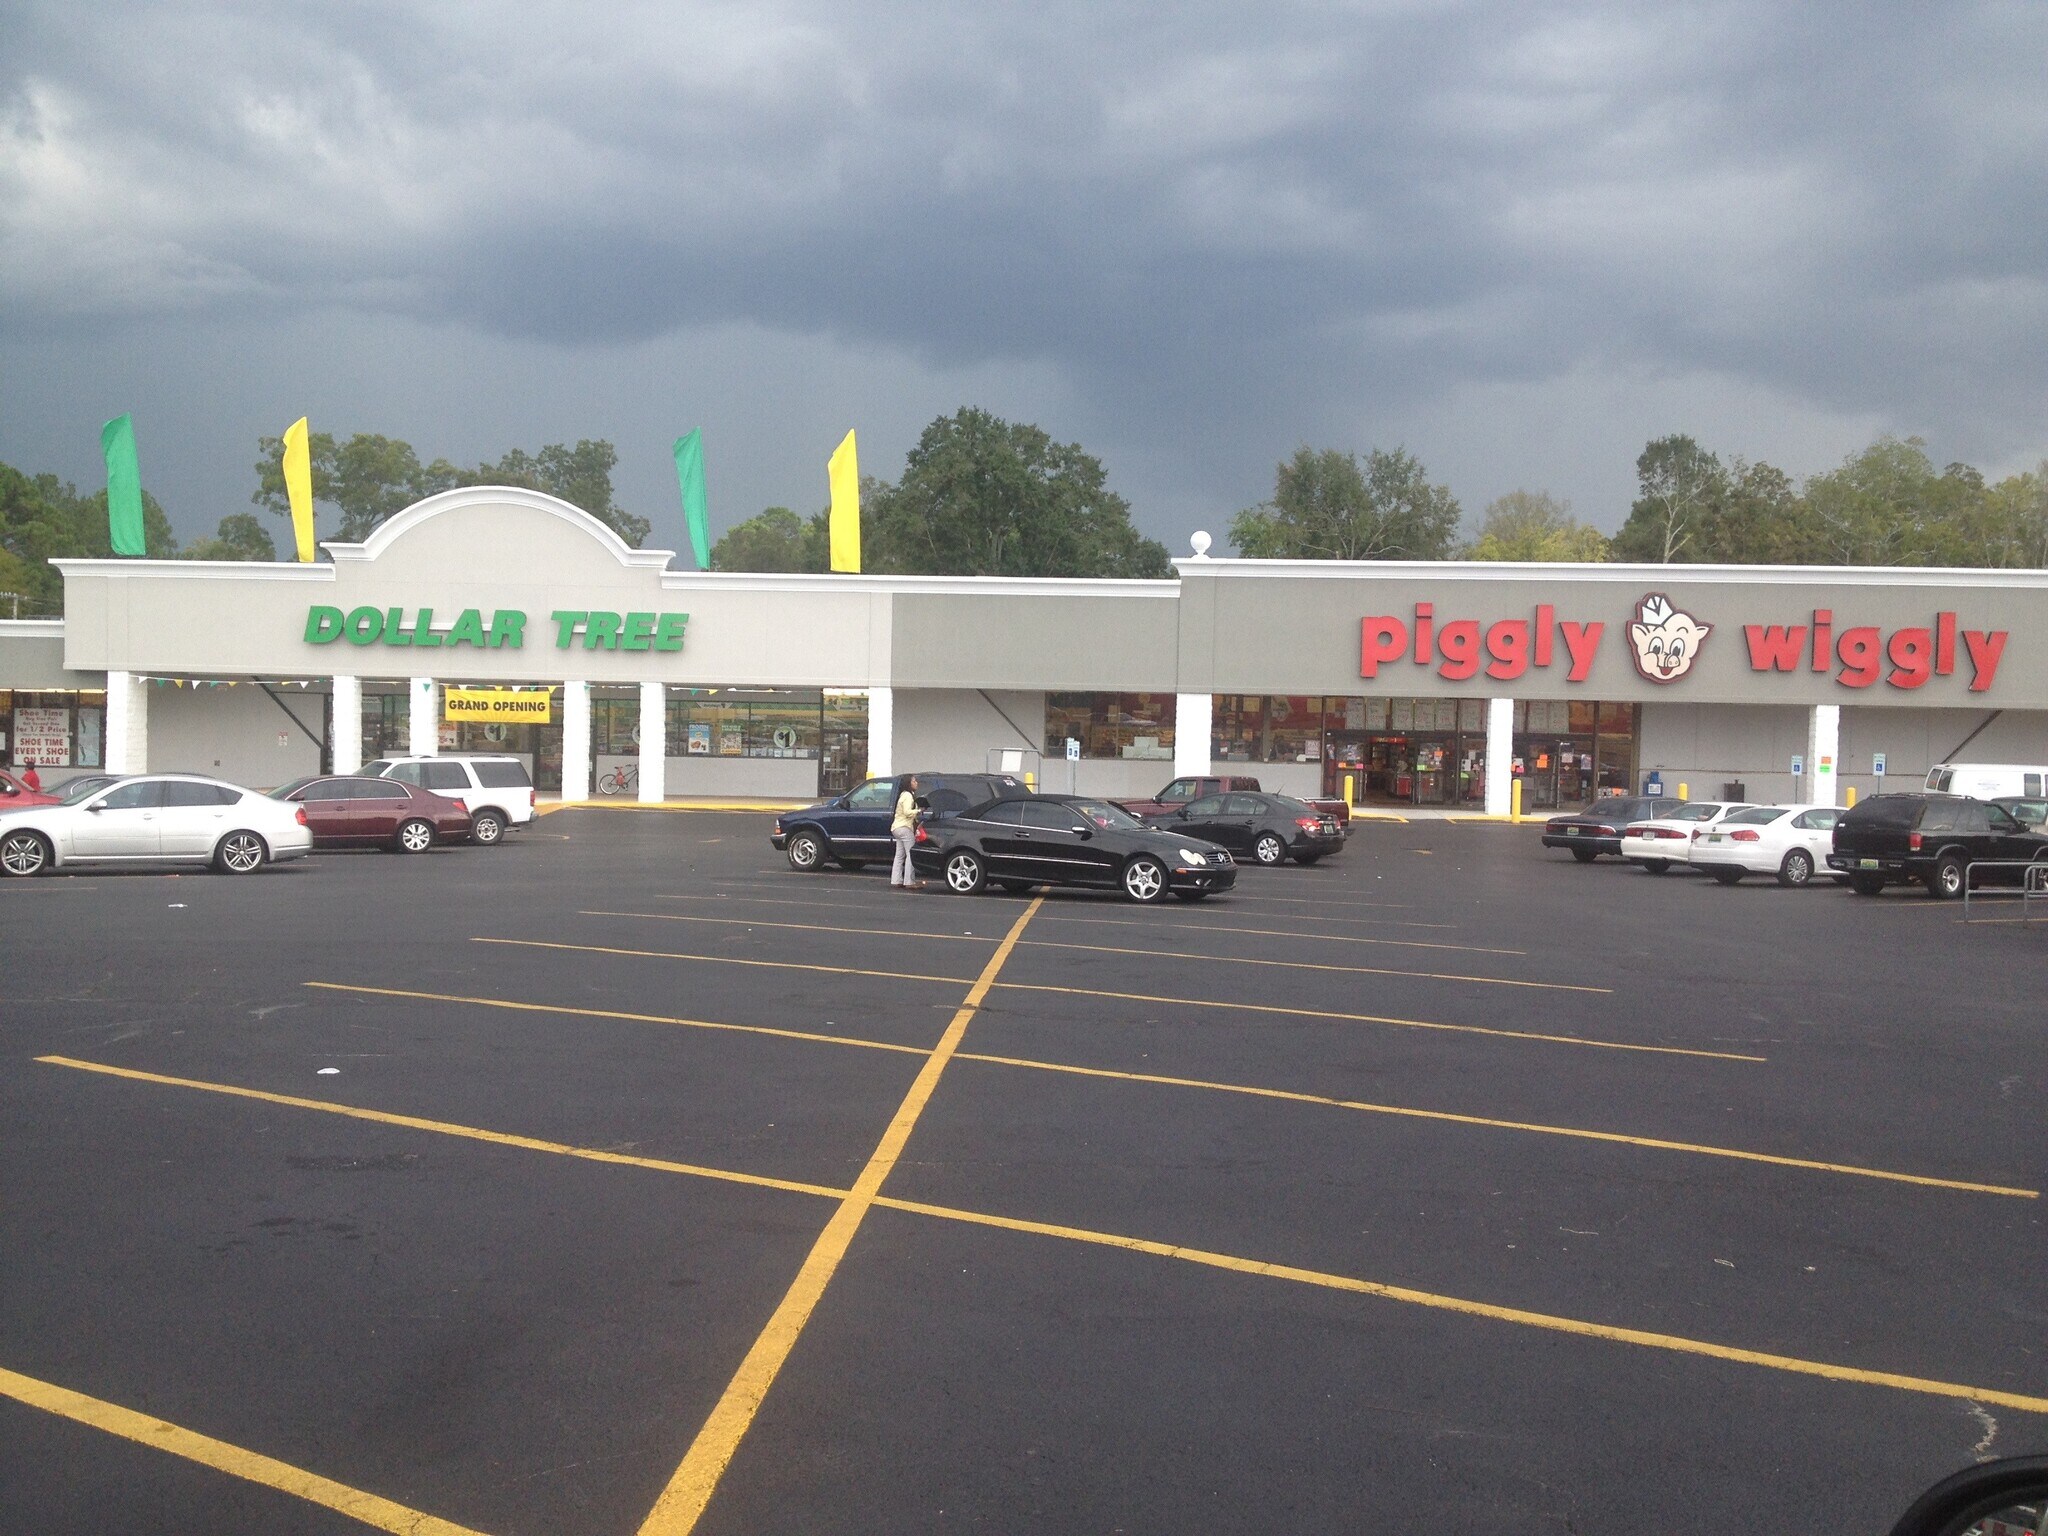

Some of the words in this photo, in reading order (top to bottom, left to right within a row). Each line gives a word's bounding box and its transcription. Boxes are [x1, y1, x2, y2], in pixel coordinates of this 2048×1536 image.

[303, 605, 527, 649] DOLLAR
[551, 610, 689, 652] TREE
[1360, 602, 1605, 681] piggly
[1744, 608, 2009, 691] wiggly
[449, 700, 489, 710] GRAND
[493, 701, 545, 711] OPENING
[20, 737, 42, 746] SHOE
[45, 738, 63, 746] TIME
[15, 747, 42, 755] EVERY
[46, 747, 69, 756] SHOE
[23, 756, 36, 764] ON
[40, 756, 60, 764] SALE
